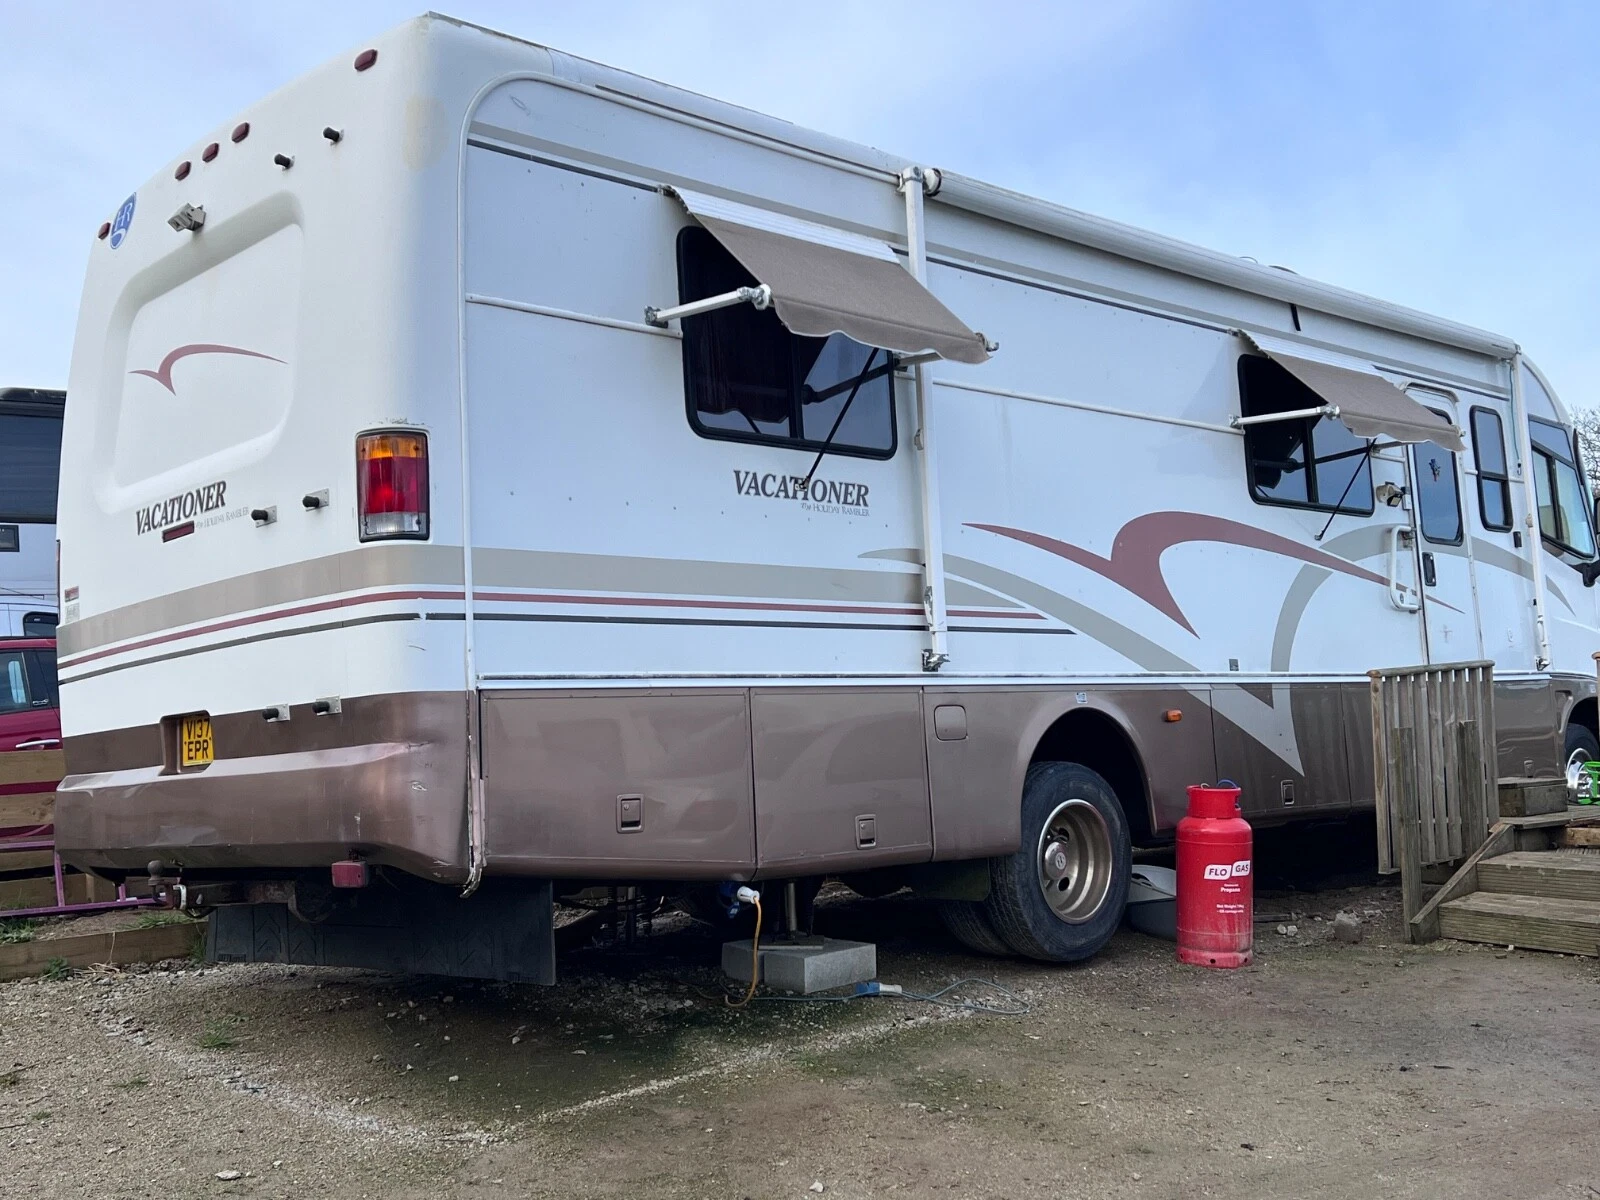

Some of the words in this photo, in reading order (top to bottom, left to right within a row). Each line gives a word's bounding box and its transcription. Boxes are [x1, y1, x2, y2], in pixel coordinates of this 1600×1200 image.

[733, 469, 870, 508] VACATIONER
[136, 480, 227, 536] VACATIONER
[813, 503, 840, 514] HOLIDAY
[841, 505, 870, 517] RAMBLER
[186, 717, 210, 740] V137
[187, 739, 209, 761] EPR
[1208, 868, 1228, 876] FLO
[1236, 864, 1248, 872] GAS
